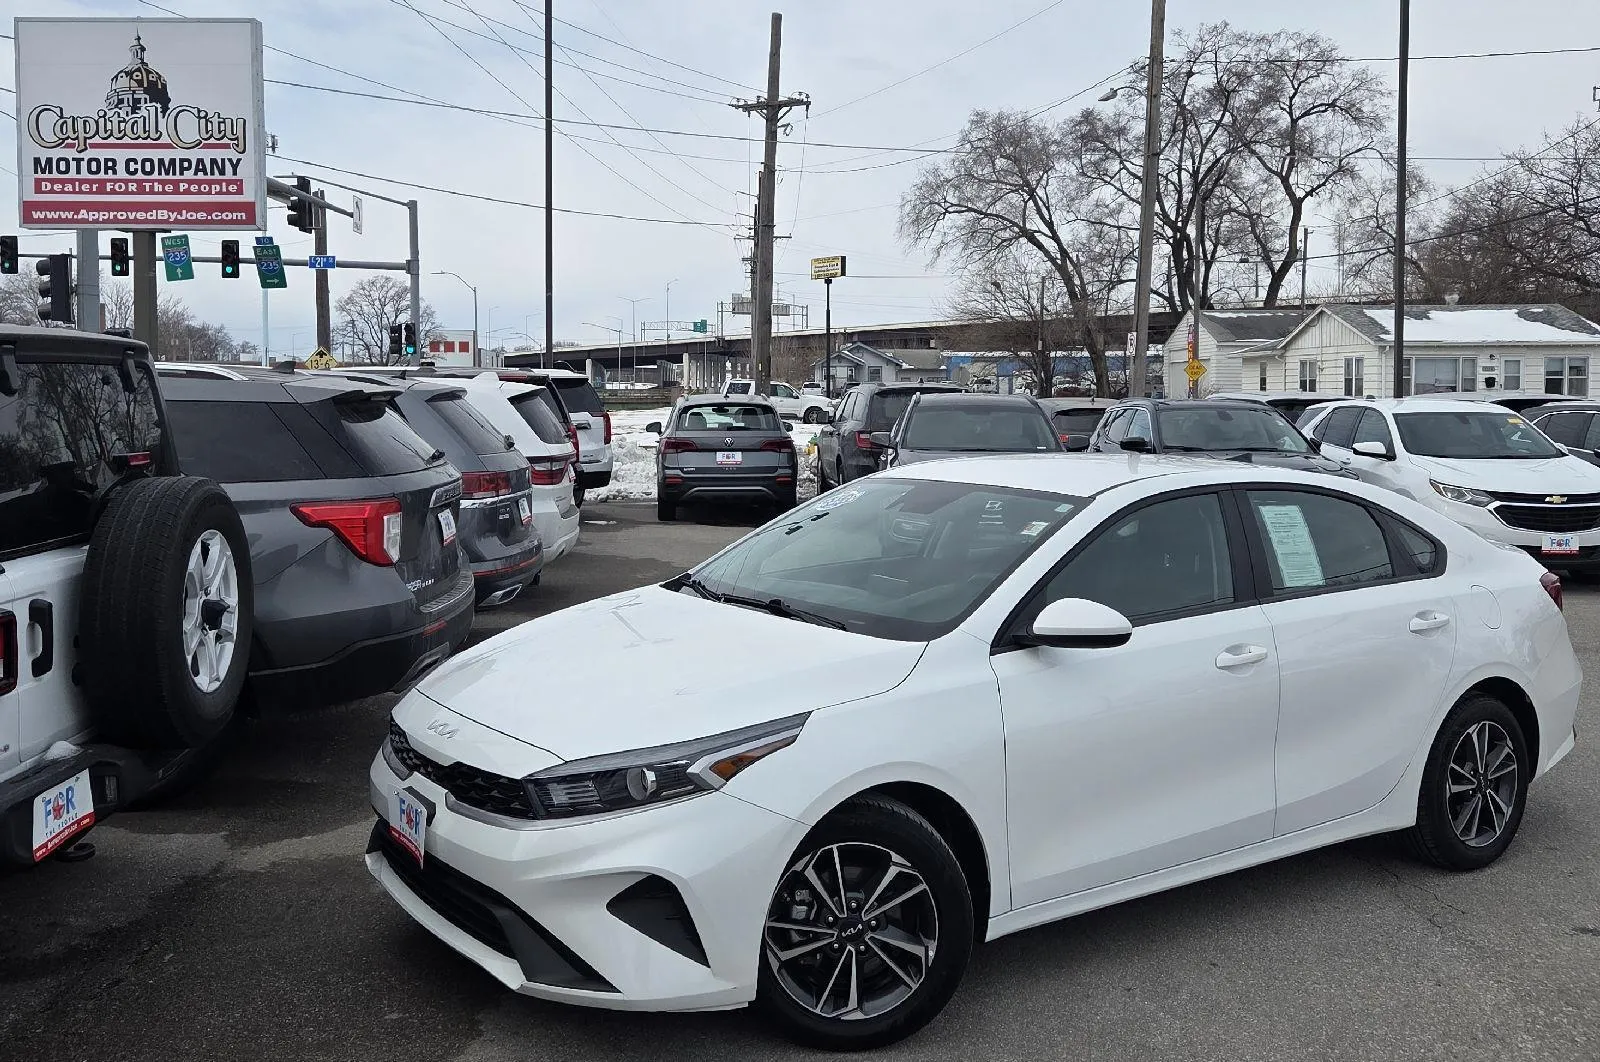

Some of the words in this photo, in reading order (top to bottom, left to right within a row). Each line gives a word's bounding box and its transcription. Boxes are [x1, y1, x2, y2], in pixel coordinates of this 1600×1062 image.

[28, 104, 162, 153] Capital
[166, 104, 247, 154] City
[33, 157, 118, 176] MOTOR
[124, 157, 243, 177] COMPANY
[41, 181, 99, 192] Dealer
[106, 182, 138, 192] FOR
[142, 182, 174, 193] The
[178, 182, 238, 195] People
[31, 208, 246, 222] www.ApprovedByJoe.com
[164, 237, 186, 246] WEST
[167, 252, 187, 262] 235
[256, 248, 277, 256] EAST
[260, 261, 280, 271] 235
[43, 785, 77, 829] FOR
